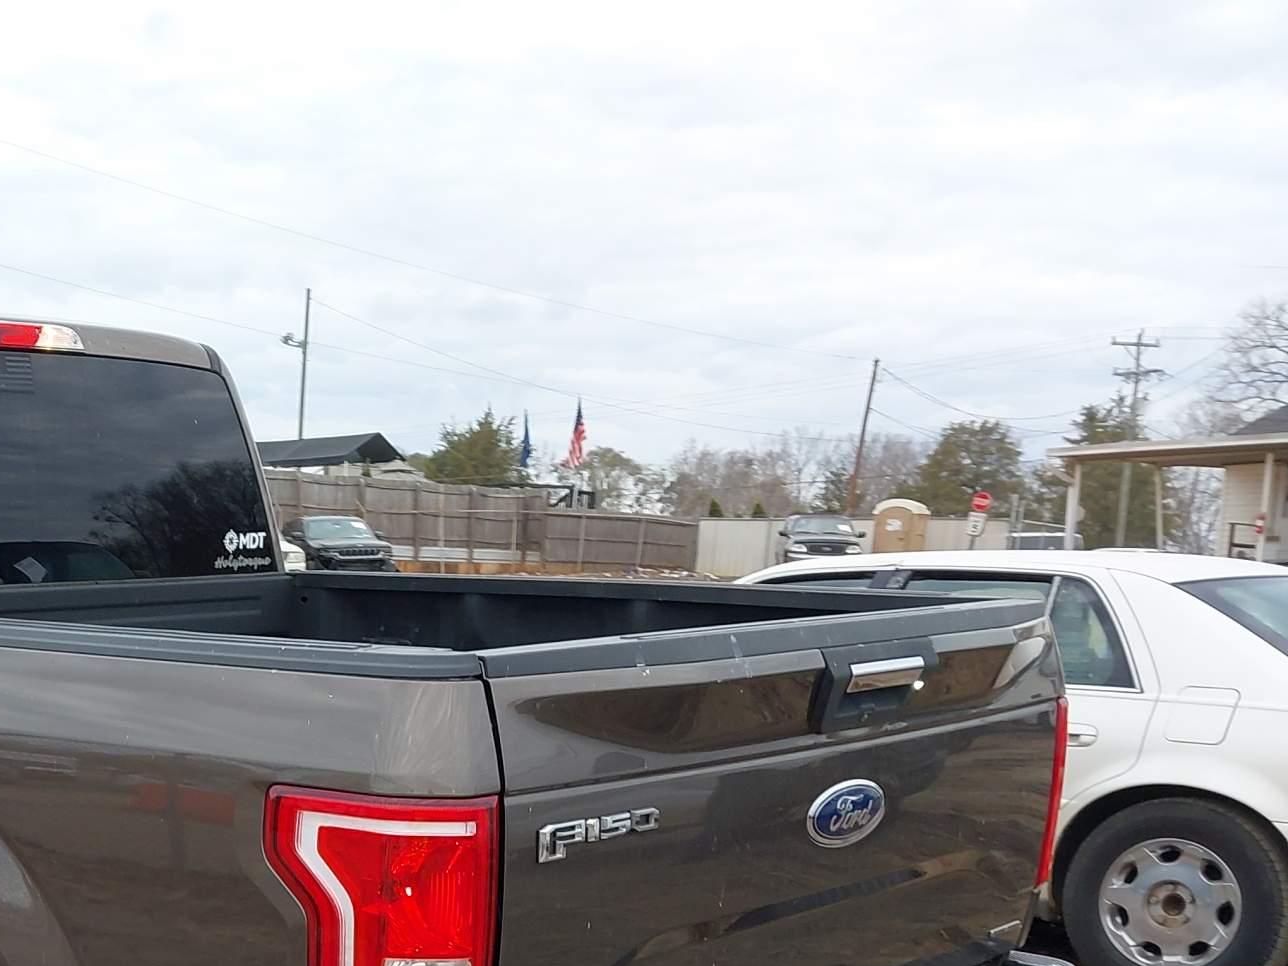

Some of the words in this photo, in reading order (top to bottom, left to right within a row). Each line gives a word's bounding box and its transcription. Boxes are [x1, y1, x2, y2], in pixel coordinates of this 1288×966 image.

[238, 531, 267, 550] MDT
[829, 793, 873, 832] Ford
[536, 807, 660, 864] F150
